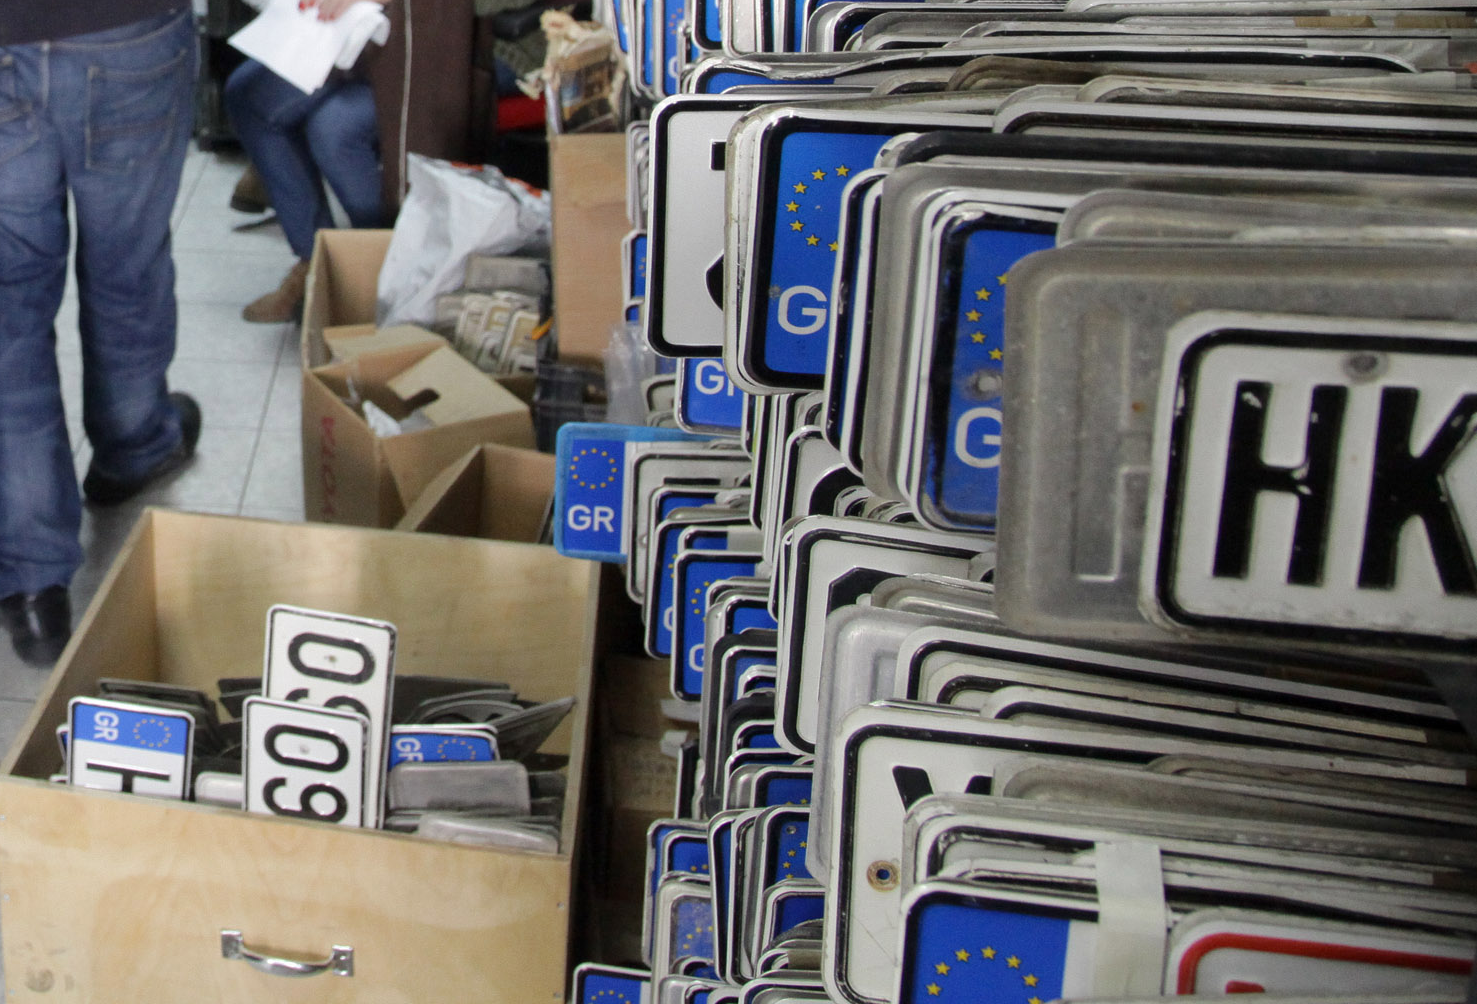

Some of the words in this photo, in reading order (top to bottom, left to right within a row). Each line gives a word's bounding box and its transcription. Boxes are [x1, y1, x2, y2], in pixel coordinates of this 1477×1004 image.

[1211, 379, 1477, 597] HK
[567, 504, 615, 534] GR
[93, 710, 120, 742] GR
